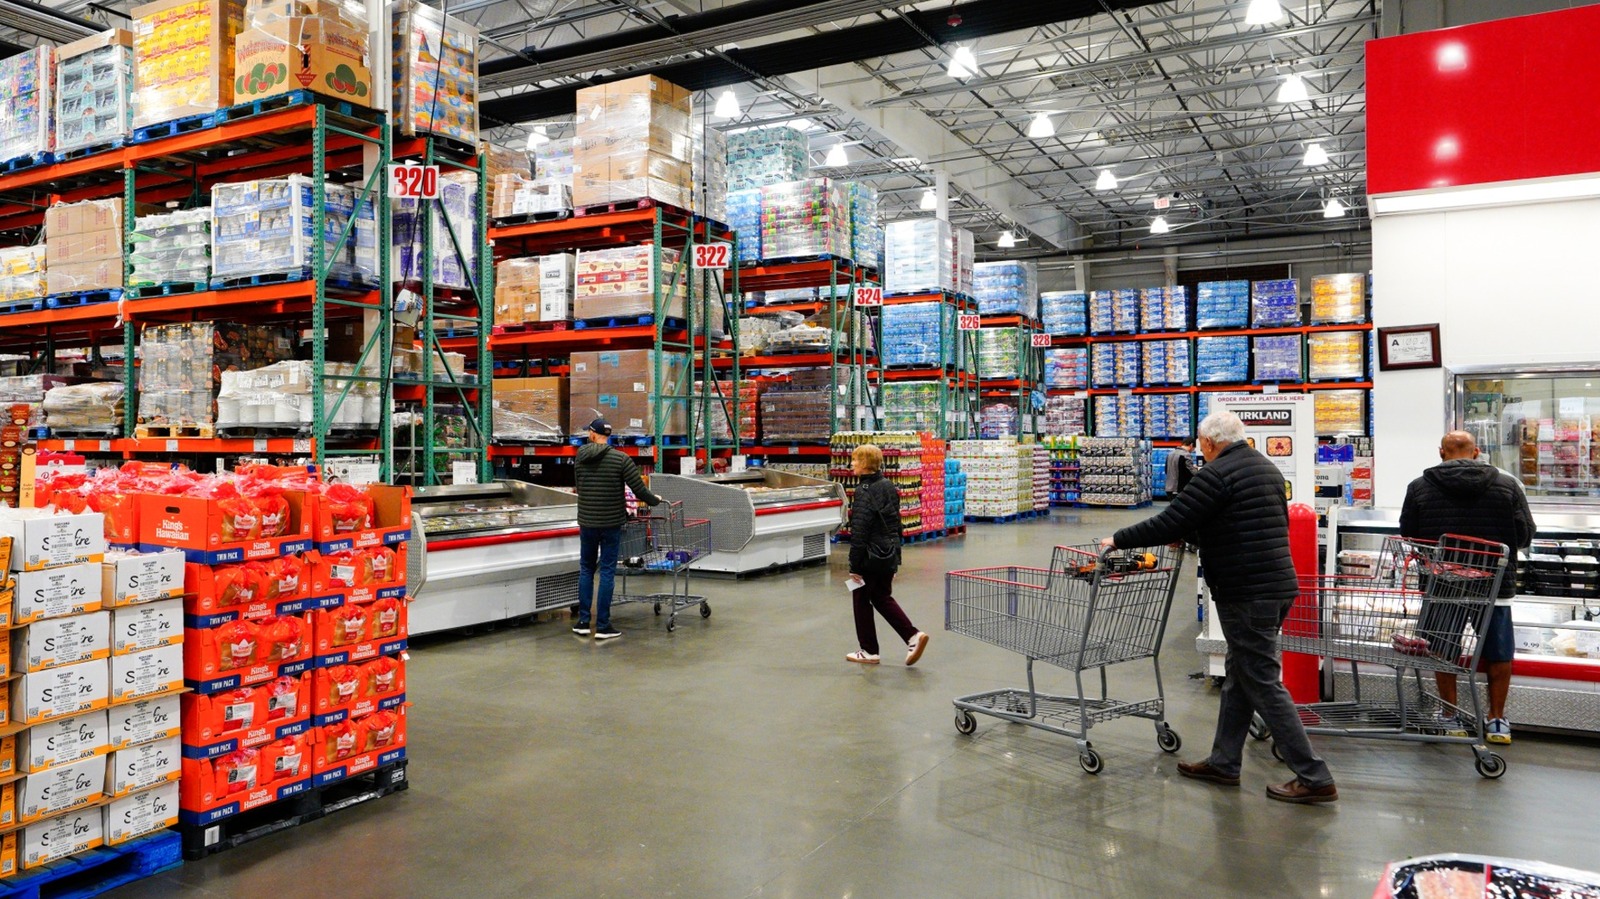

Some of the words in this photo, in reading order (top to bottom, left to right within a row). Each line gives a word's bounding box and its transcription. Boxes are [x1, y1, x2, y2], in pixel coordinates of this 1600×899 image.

[394, 167, 436, 197] 320
[696, 246, 726, 266] 322
[857, 288, 881, 304] 324
[960, 316, 979, 329] 326
[1033, 335, 1050, 346] 328
[162, 519, 183, 531] King's
[156, 528, 190, 541] Hawaiian
[340, 542, 349, 550] PACK
[356, 538, 380, 547] Hawaiian
[217, 552, 226, 561] TWIN
[228, 552, 238, 560] PACK
[247, 548, 276, 558] Hawaiian
[382, 590, 390, 598] TWIN
[391, 589, 400, 597] PACK
[282, 604, 292, 612] TWIN
[293, 602, 303, 611] PACK
[320, 598, 330, 606] TWIN
[210, 616, 220, 626] TWIN
[221, 615, 232, 624] PACK
[384, 644, 392, 652] TWIN
[393, 642, 401, 650] PACK
[324, 656, 333, 664] TWIN
[334, 654, 344, 663] PACK
[284, 665, 294, 674] TWIN
[295, 663, 305, 672] PACK
[211, 680, 222, 690] TWIN
[223, 678, 234, 688] PACK
[383, 699, 391, 707] TWIN
[392, 698, 400, 706] PACK
[324, 714, 333, 722] TWIN
[334, 712, 343, 722] PACK
[282, 726, 291, 736] TWIN
[292, 724, 302, 734] PACK
[242, 734, 271, 746] Hawaiian
[208, 745, 219, 756] TWIN
[220, 742, 231, 752] PACK
[382, 752, 390, 761] TWIN
[391, 750, 399, 759] PACK
[323, 772, 332, 782] TWIN
[332, 770, 342, 780] PACK
[282, 787, 292, 796] TWIN
[293, 784, 302, 793] PACK
[244, 795, 272, 809] Hawaiian
[210, 808, 221, 820] TWIN
[222, 806, 233, 816] PACK
